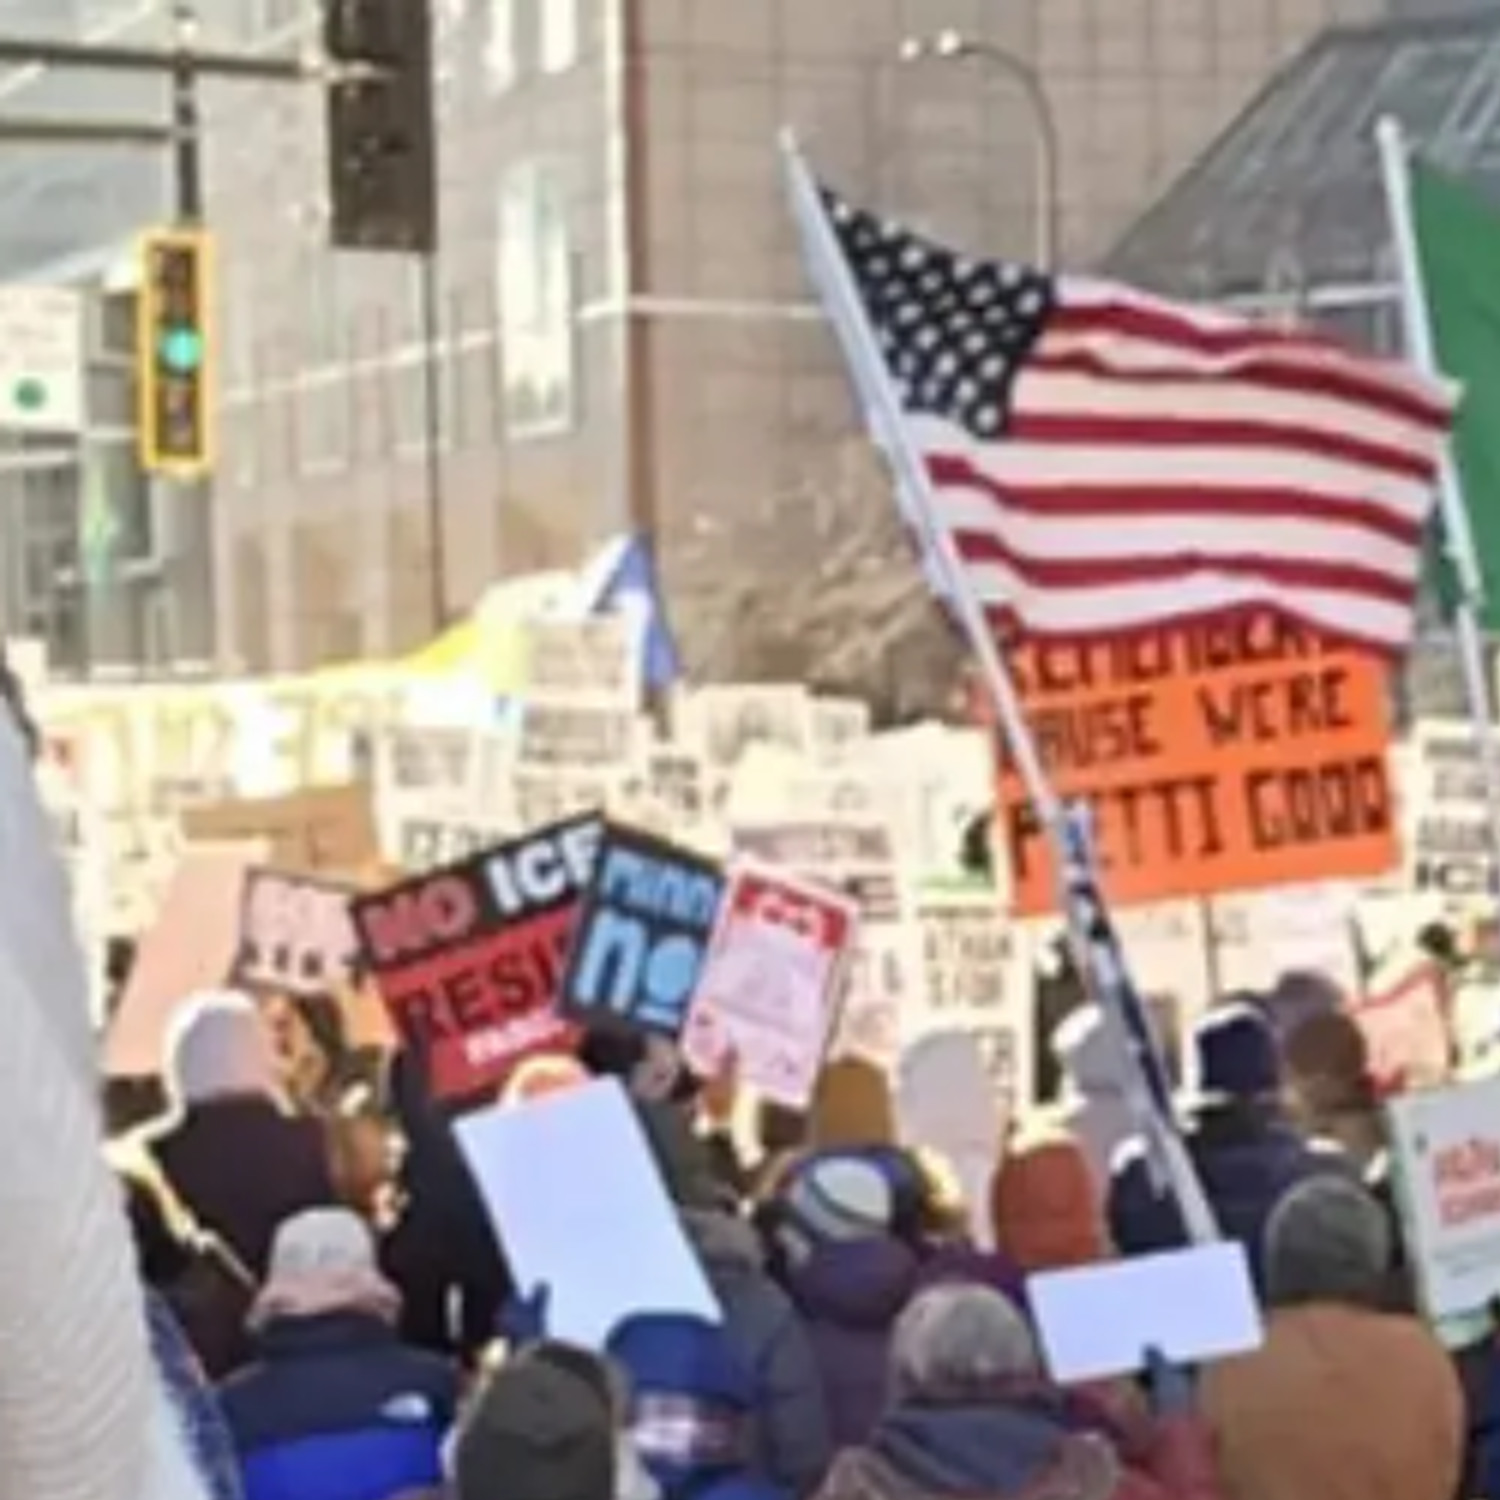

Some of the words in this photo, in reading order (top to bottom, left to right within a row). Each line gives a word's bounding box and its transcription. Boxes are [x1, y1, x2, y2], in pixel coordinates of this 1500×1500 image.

[1000, 695, 1161, 774] AUSE
[1012, 770, 1225, 880] PTTI
[1244, 755, 1390, 852] GOOD
[398, 925, 574, 1042] RESI
